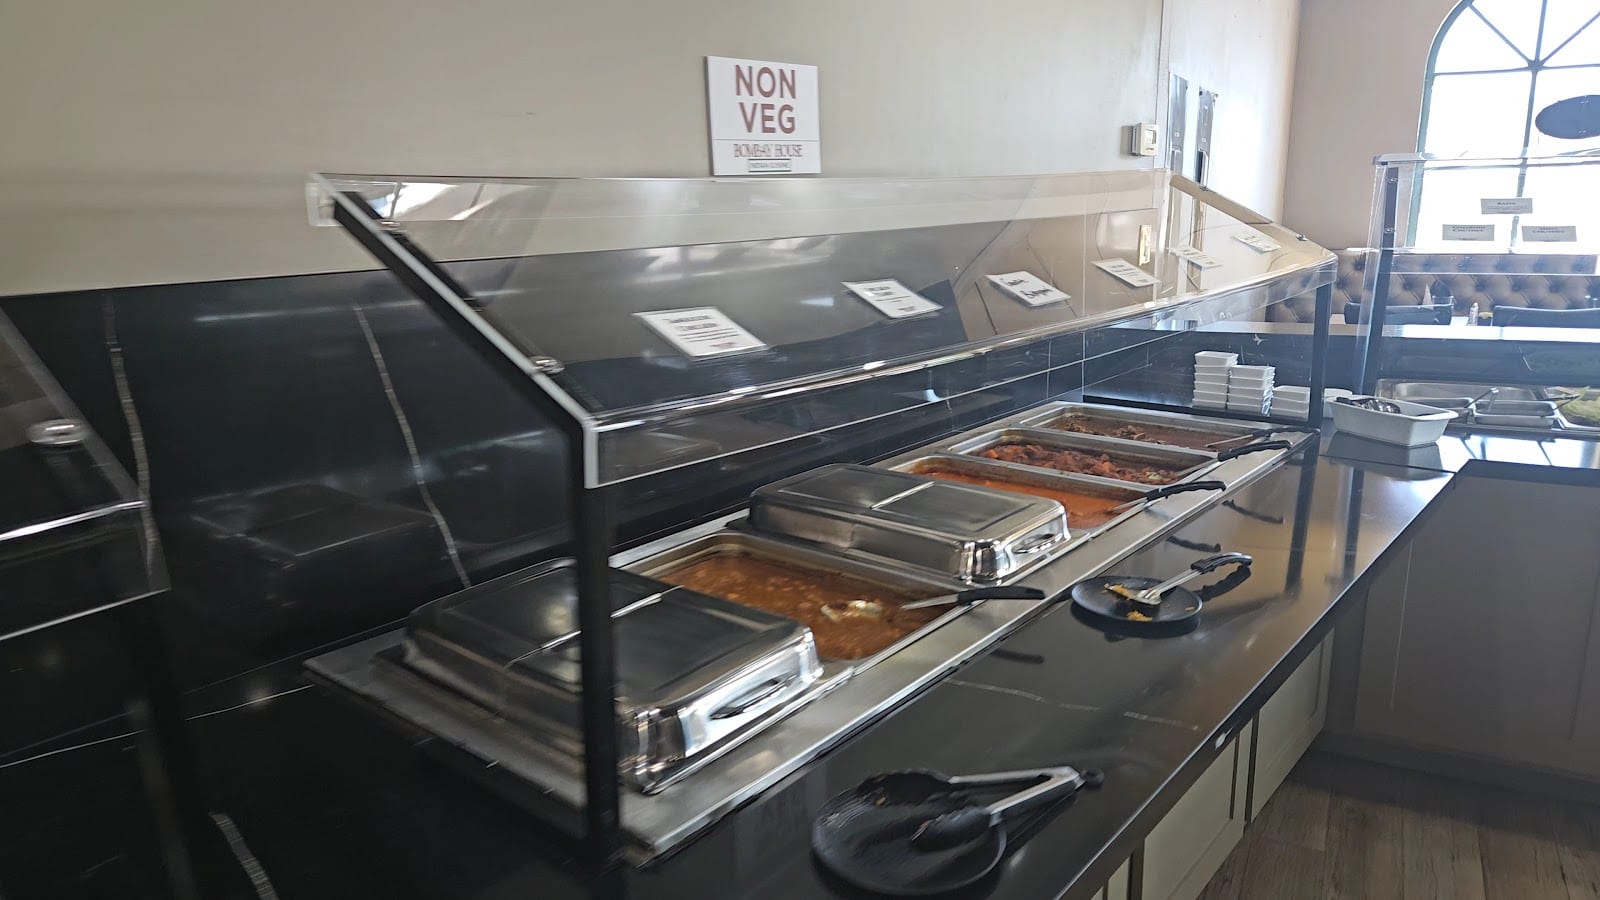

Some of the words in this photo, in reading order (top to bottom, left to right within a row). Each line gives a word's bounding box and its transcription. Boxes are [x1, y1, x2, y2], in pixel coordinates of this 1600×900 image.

[735, 65, 796, 99] NON
[739, 102, 796, 134] VEG
[733, 143, 771, 157] BOMBAY
[774, 144, 803, 157] HOUSE
